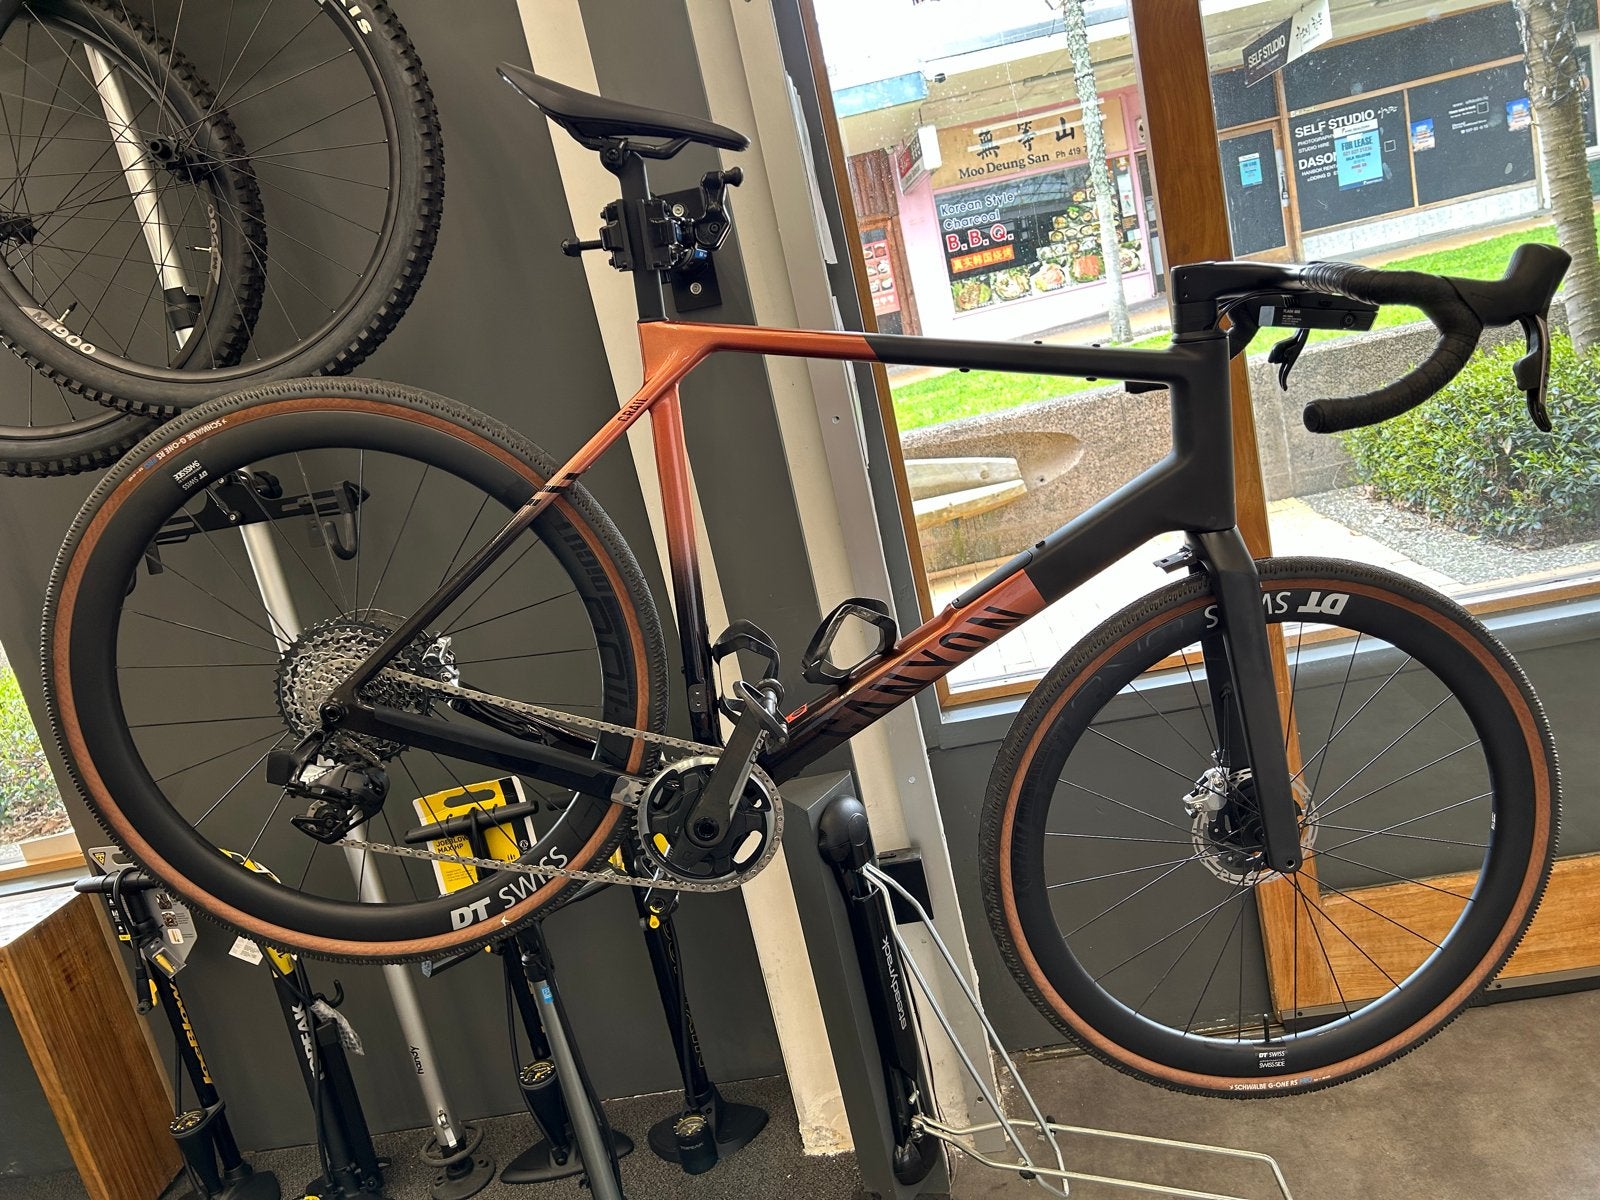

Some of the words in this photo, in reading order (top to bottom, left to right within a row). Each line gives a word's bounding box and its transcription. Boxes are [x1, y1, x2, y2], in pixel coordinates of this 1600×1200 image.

[1248, 48, 1263, 68] SELF
[1262, 35, 1286, 59] STUDIO
[1294, 120, 1327, 139] SELF
[1328, 109, 1375, 130] STUDIO
[1055, 150, 1066, 159] Ph
[1068, 146, 1081, 156] 419
[1354, 135, 1374, 148] LEASE
[958, 165, 985, 180] Moo
[985, 154, 1026, 174] Deung
[1027, 152, 1050, 165] San
[940, 200, 983, 217] Korean
[984, 191, 1017, 208] Style
[943, 208, 1001, 231] Charcoal
[186, 420, 223, 441] SCHWALBE
[165, 437, 187, 455] G-ONE
[182, 476, 200, 491] SWISS
[198, 470, 209, 481] DT
[1297, 591, 1351, 616] DT
[820, 606, 1030, 739] CANYON
[436, 836, 470, 848] JOEBLOW
[437, 845, 452, 854] MAX
[454, 843, 464, 851] HP
[450, 896, 491, 931] DT
[498, 846, 568, 909] SWISS
[882, 935, 908, 1031] steadyrack
[169, 982, 214, 1084] JoeBlow
[409, 1045, 425, 1075] handy
[1268, 1050, 1286, 1058] SWISS
[1233, 1082, 1267, 1091] SCHWALBE
[1267, 1080, 1290, 1089] G-ONE
[1290, 1079, 1298, 1087] RS
